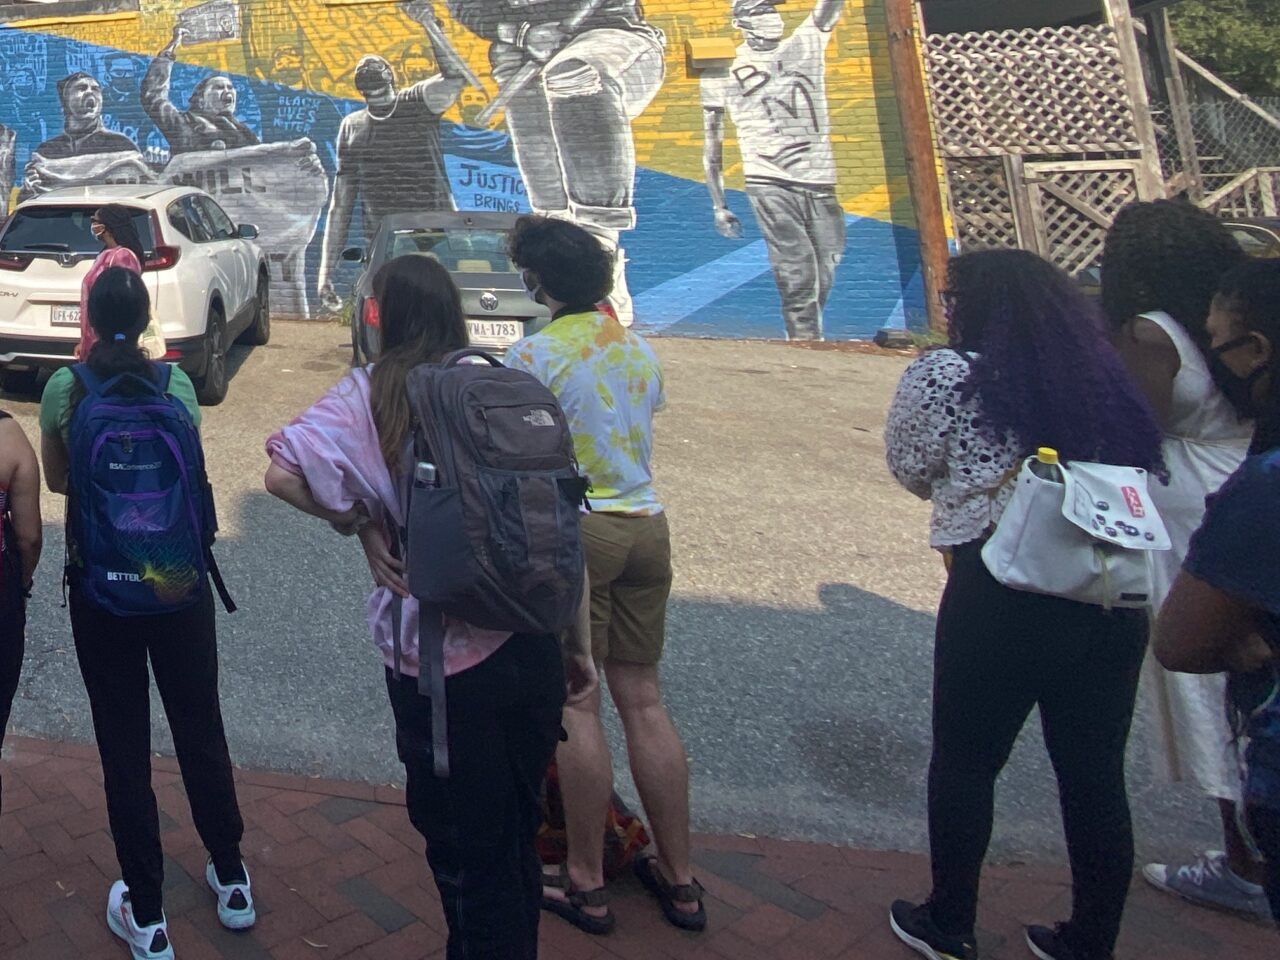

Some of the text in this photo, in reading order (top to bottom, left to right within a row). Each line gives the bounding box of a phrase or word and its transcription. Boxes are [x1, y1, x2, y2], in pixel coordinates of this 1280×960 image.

[278, 107, 316, 123] LIVES
[460, 163, 528, 196] JUSTIC
[474, 193, 521, 213] BRINGS
